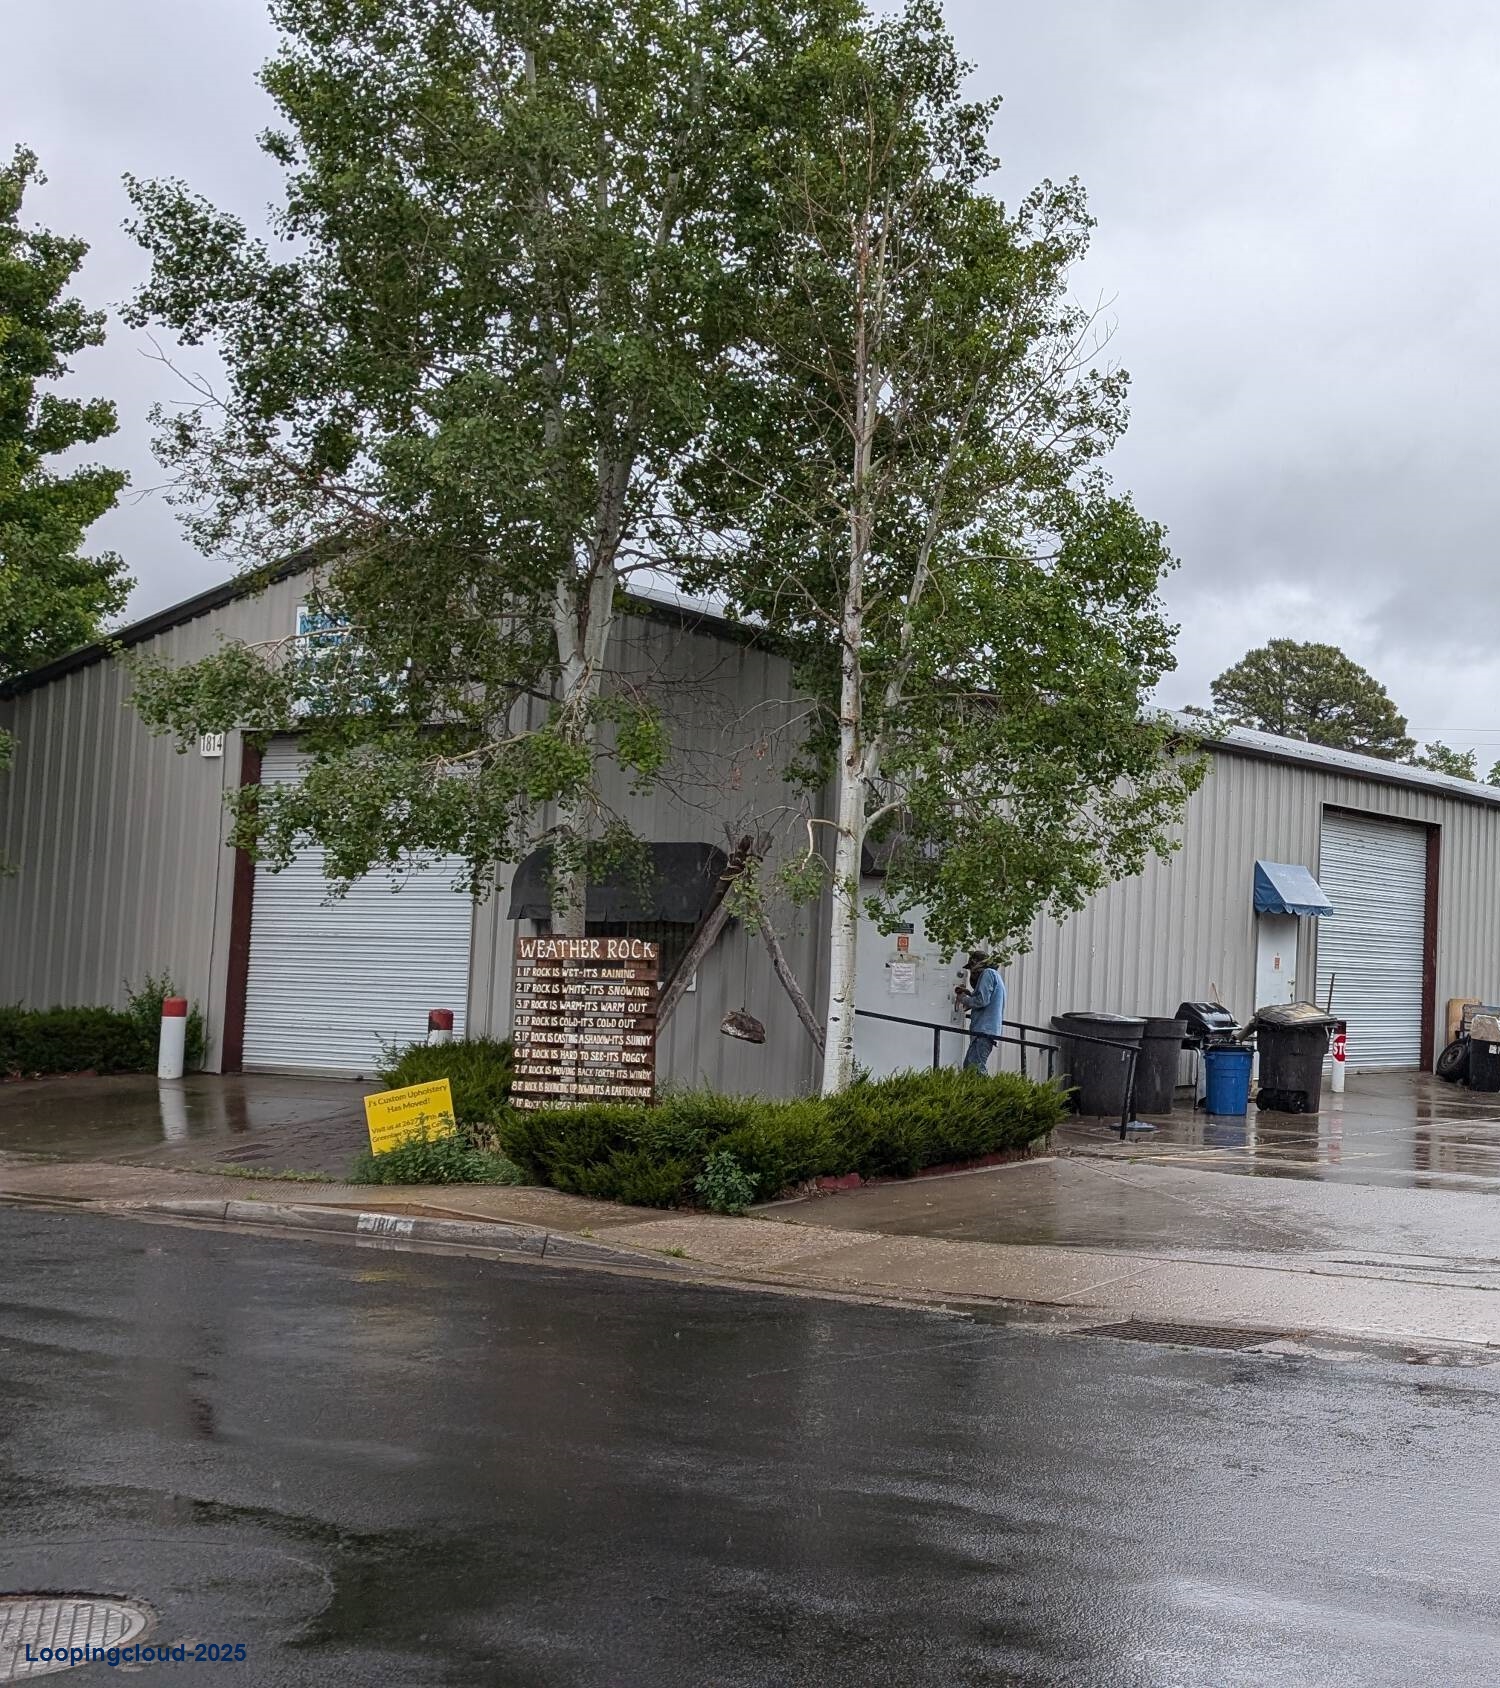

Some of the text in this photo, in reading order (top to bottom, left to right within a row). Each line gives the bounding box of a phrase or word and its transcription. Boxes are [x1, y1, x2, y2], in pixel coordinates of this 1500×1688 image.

[202, 735, 222, 751] 1814
[520, 939, 656, 959] WEATHER ROCK
[523, 968, 531, 977] IF
[532, 968, 551, 977] ROCK
[552, 968, 560, 977] IS
[601, 968, 635, 979] RAINING
[523, 984, 531, 993] IF
[532, 984, 550, 993] ROCK
[552, 984, 560, 993] IS
[607, 986, 650, 996] SNOWING
[523, 1000, 530, 1009] IF
[531, 1000, 548, 1009] ROCK
[549, 1000, 557, 1010] IS
[601, 1002, 625, 1012] WARM
[628, 1003, 648, 1013] OUT
[531, 1016, 549, 1026] ROCK
[551, 1016, 558, 1026] IS
[596, 1018, 617, 1028] COLD
[618, 1019, 637, 1029] OUT
[522, 1032, 530, 1042] IF
[530, 1032, 547, 1042] ROCK
[547, 1033, 554, 1043] IS
[554, 1033, 578, 1044] CASTING
[625, 1035, 652, 1046] SUNNY
[522, 1048, 530, 1058] IF
[532, 1049, 549, 1058] ROCK
[551, 1049, 558, 1059] IS
[560, 1050, 578, 1059] HARD
[580, 1051, 589, 1060] TO
[621, 1052, 647, 1063] FOGGY
[528, 1065, 544, 1074] ROCK
[545, 1065, 552, 1074] IS
[552, 1066, 576, 1076] MOVING
[577, 1068, 593, 1077] BACK
[629, 1069, 652, 1080] WINDY
[378, 1094, 406, 1105] Custom
[408, 1084, 447, 1099] Upholstery
[524, 1082, 538, 1092] ROCK
[539, 1082, 544, 1092] IS
[569, 1083, 578, 1094] UP
[605, 1085, 611, 1096] A
[611, 1086, 652, 1098] EARTHQUAKE
[387, 1097, 430, 1113] Has Moved!
[372, 1126, 385, 1134] Visit
